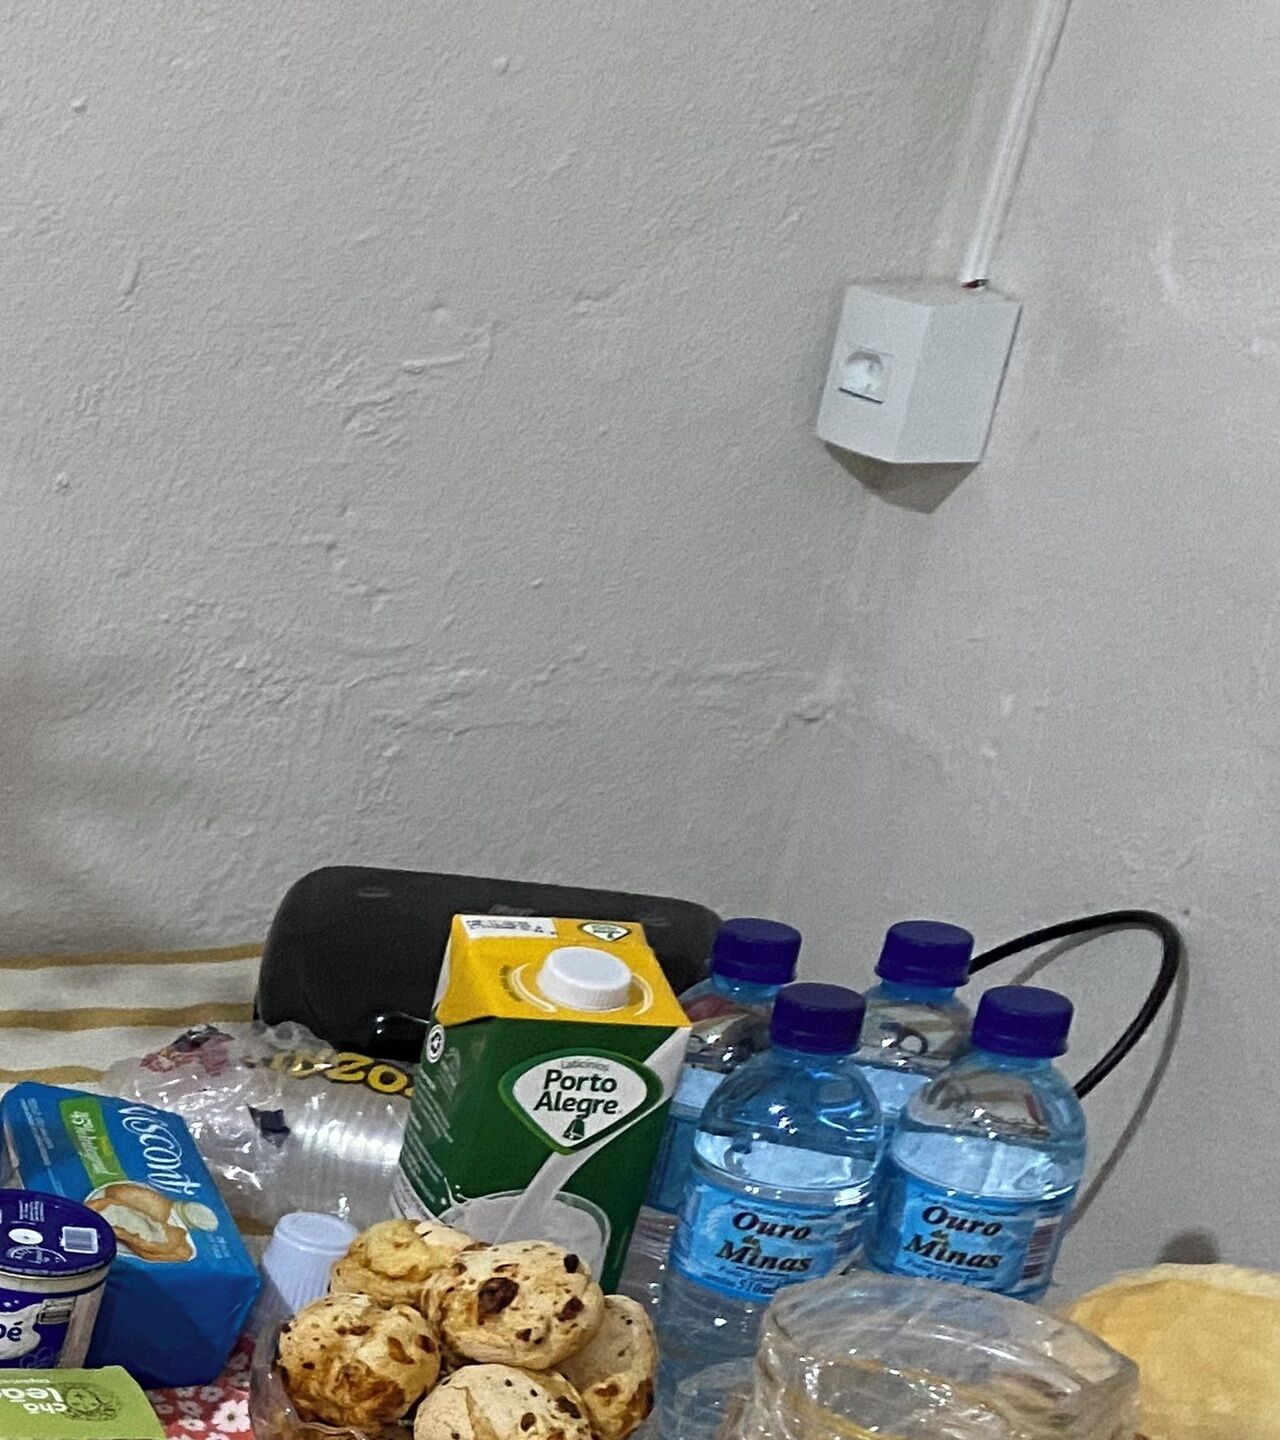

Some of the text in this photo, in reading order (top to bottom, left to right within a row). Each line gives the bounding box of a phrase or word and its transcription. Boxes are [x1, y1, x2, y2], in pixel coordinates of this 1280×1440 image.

[544, 1069, 617, 1093] Porto
[533, 1091, 618, 1119] Alegre
[732, 1212, 812, 1239] Ouro
[922, 1205, 1003, 1236] Ouro
[715, 1240, 813, 1272] Minas
[903, 1234, 1003, 1268] Minas
